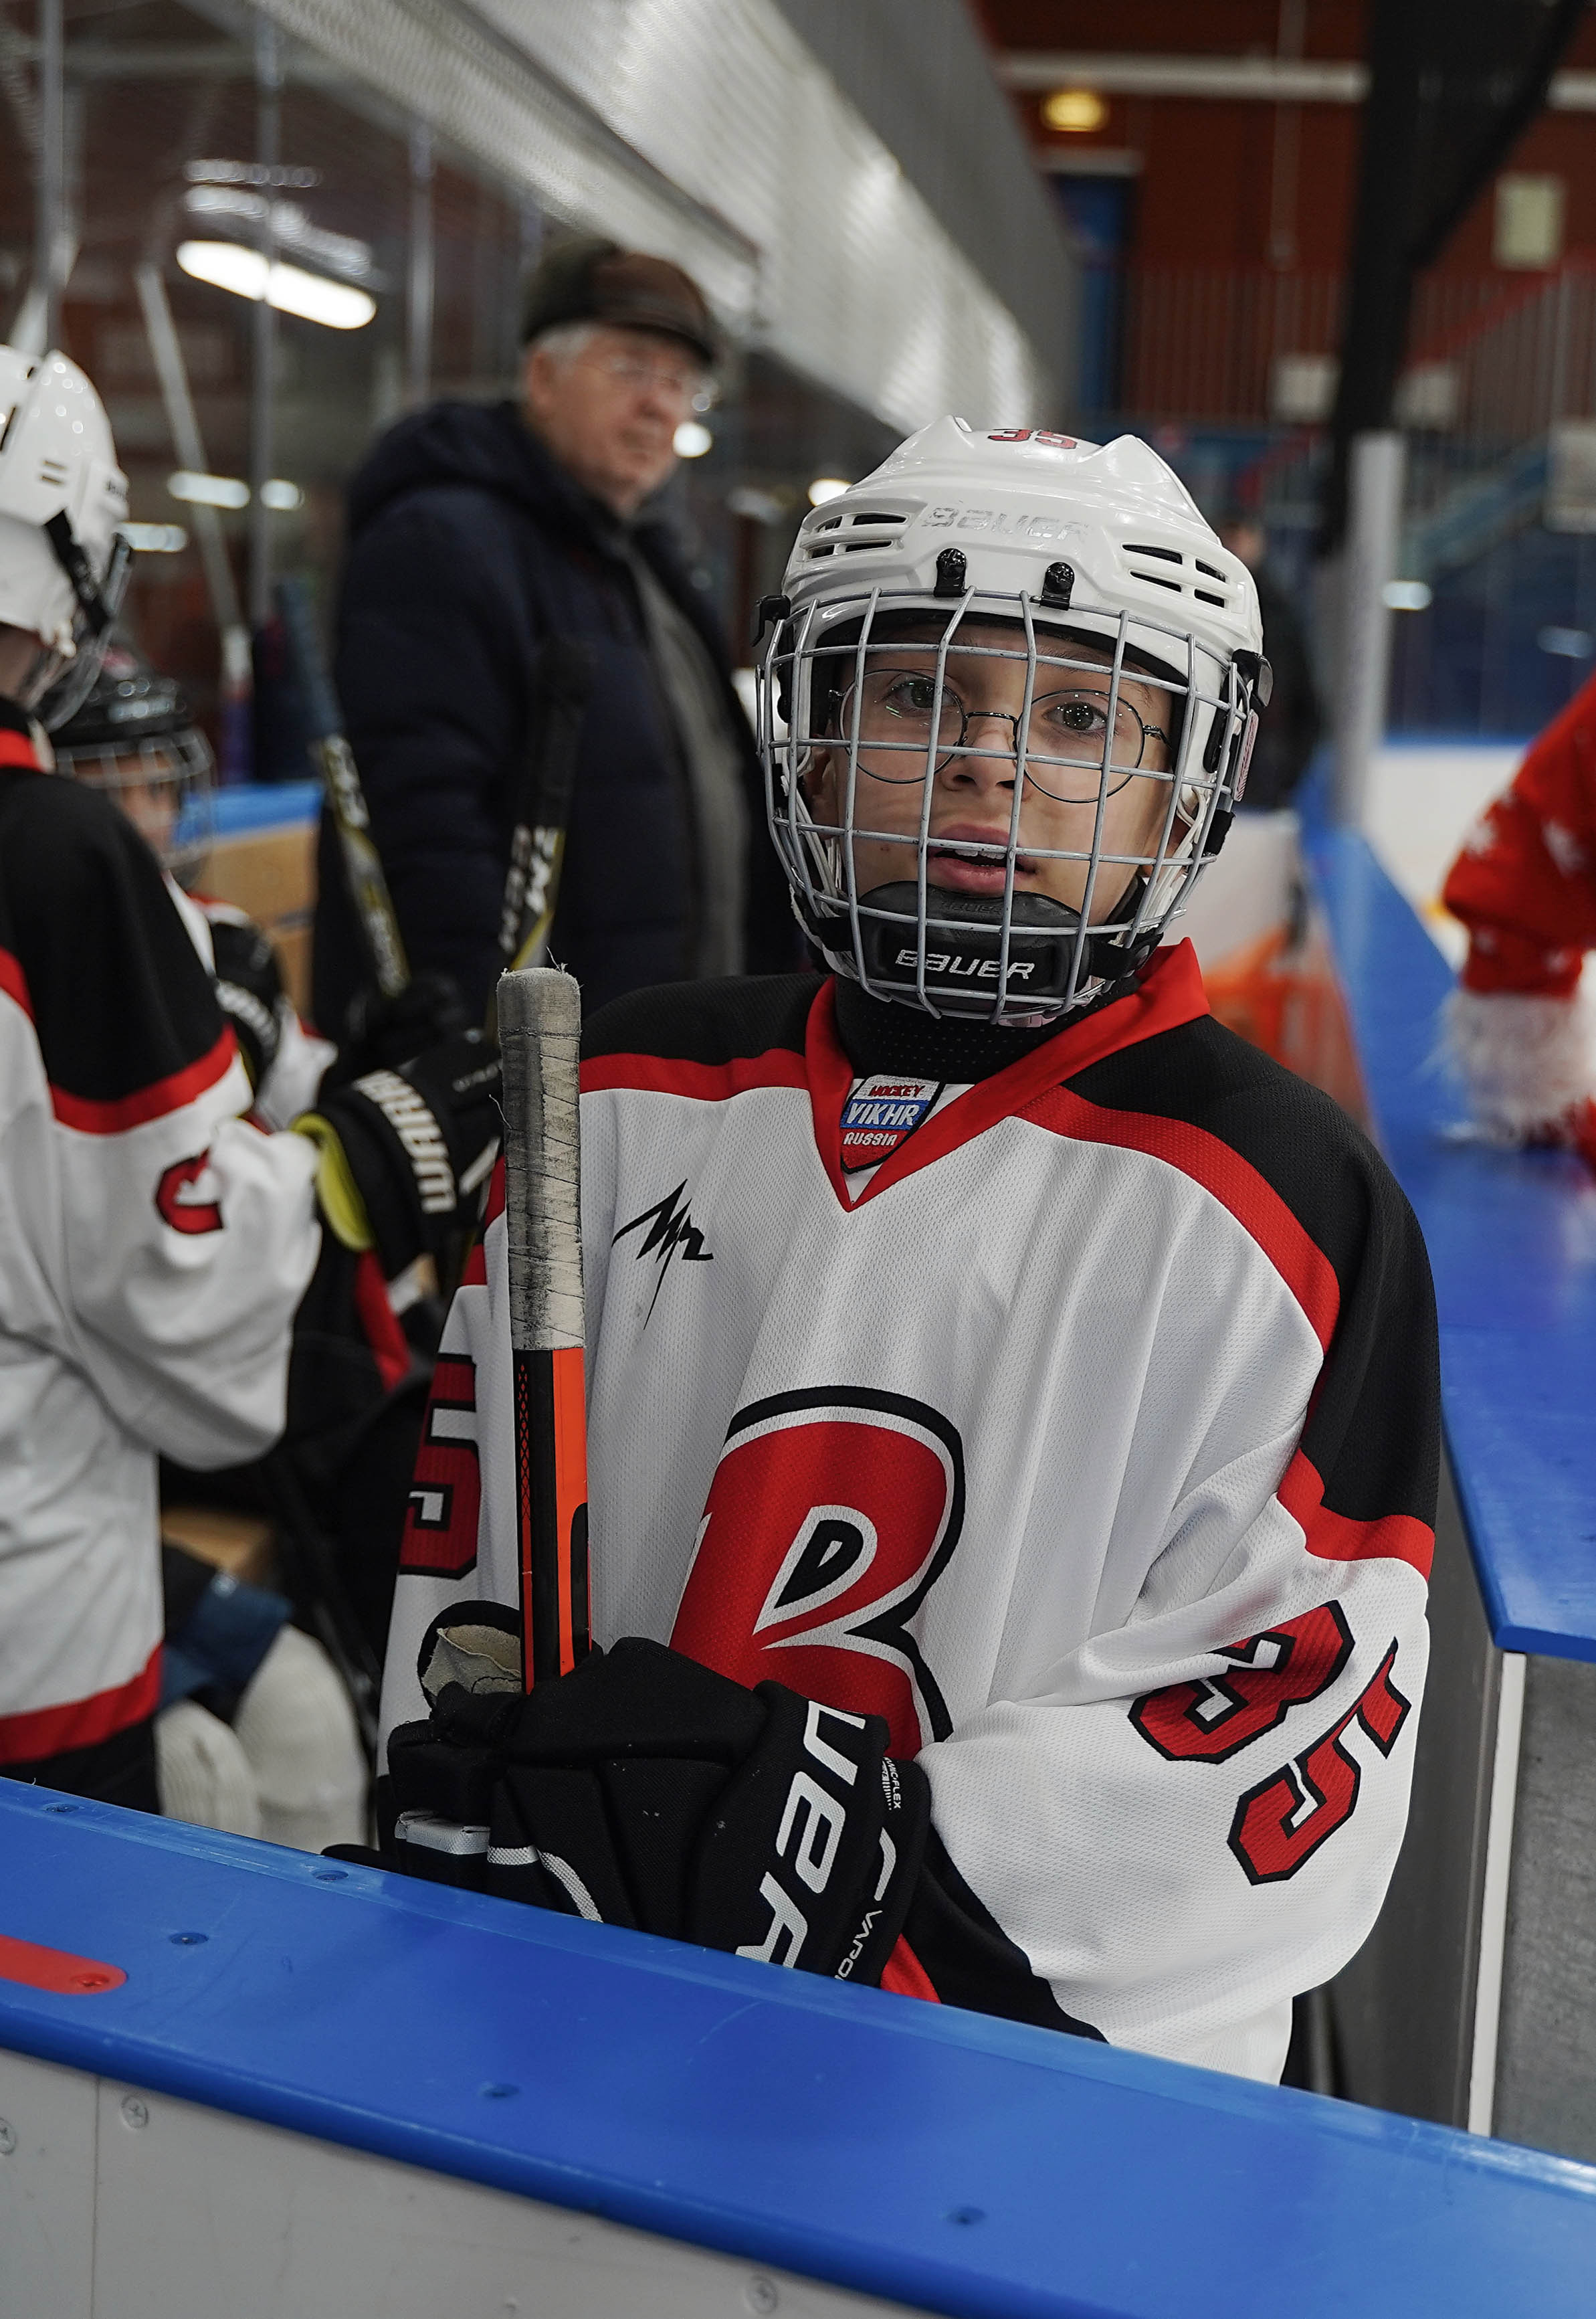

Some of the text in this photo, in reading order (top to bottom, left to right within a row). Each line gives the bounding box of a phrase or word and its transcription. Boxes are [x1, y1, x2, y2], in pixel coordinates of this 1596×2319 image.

[987, 429, 1078, 449] 35
[922, 506, 1089, 542] BAUER
[895, 949, 1035, 980] BAUER
[846, 1103, 920, 1126] VIKHR
[843, 1131, 898, 1146] RUSSIA
[1128, 1600, 1412, 1886] 35
[735, 1699, 867, 1970] UER
[834, 1910, 884, 1981] VAPO
